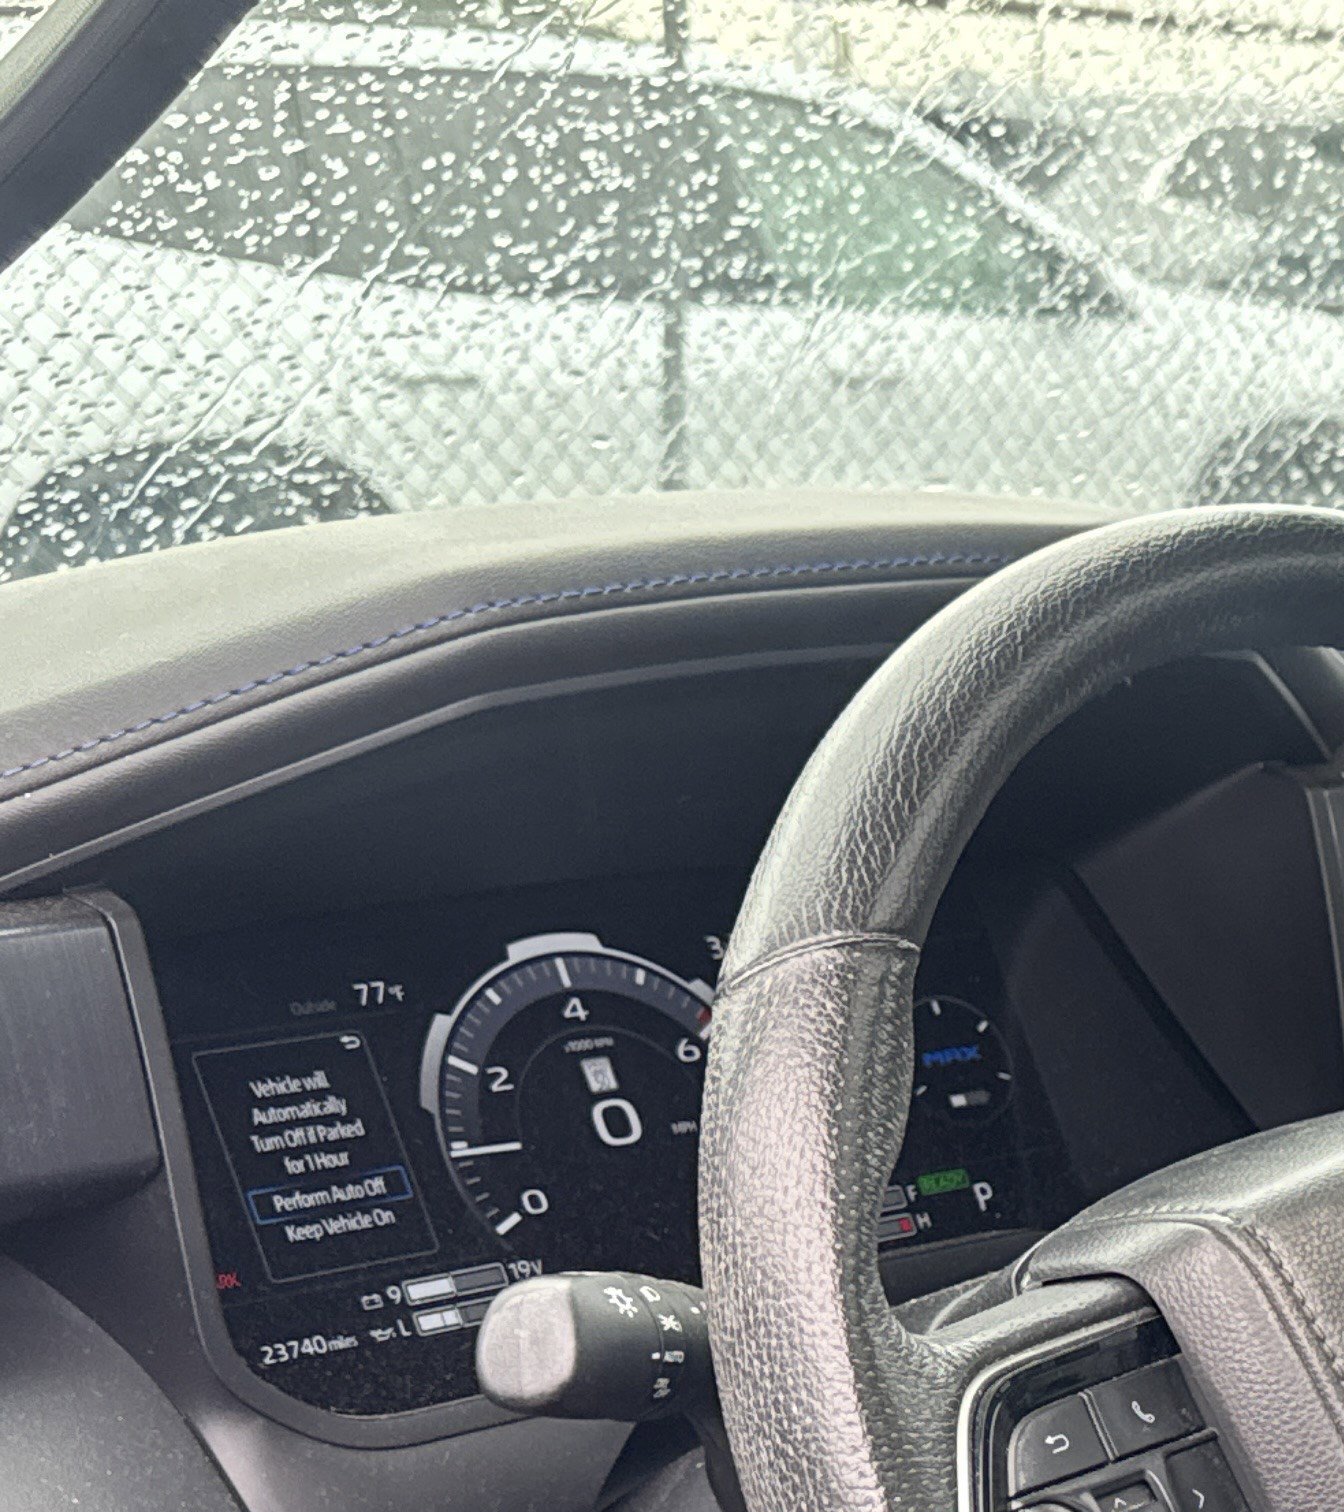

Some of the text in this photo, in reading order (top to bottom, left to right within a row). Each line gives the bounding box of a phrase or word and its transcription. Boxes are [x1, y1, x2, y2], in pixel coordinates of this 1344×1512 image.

[563, 997, 590, 1022] 4
[677, 1038, 701, 1063] 6
[249, 1070, 331, 1098] Vehicle will
[486, 1066, 515, 1093] 2
[252, 1095, 348, 1126] Automatically
[591, 1098, 643, 1147] 0
[250, 1134, 286, 1154] Turn
[284, 1126, 307, 1148] Off
[316, 1117, 366, 1143] Parked
[284, 1151, 350, 1176] for 1 Hour
[272, 1176, 388, 1213] Perform Auto Off
[521, 1189, 549, 1215] 0
[905, 1183, 918, 1202] F
[973, 1181, 993, 1212] P
[285, 1208, 396, 1244] Keep Vehicle On
[916, 1212, 932, 1229] H
[261, 1334, 359, 1365] 23740 miles
